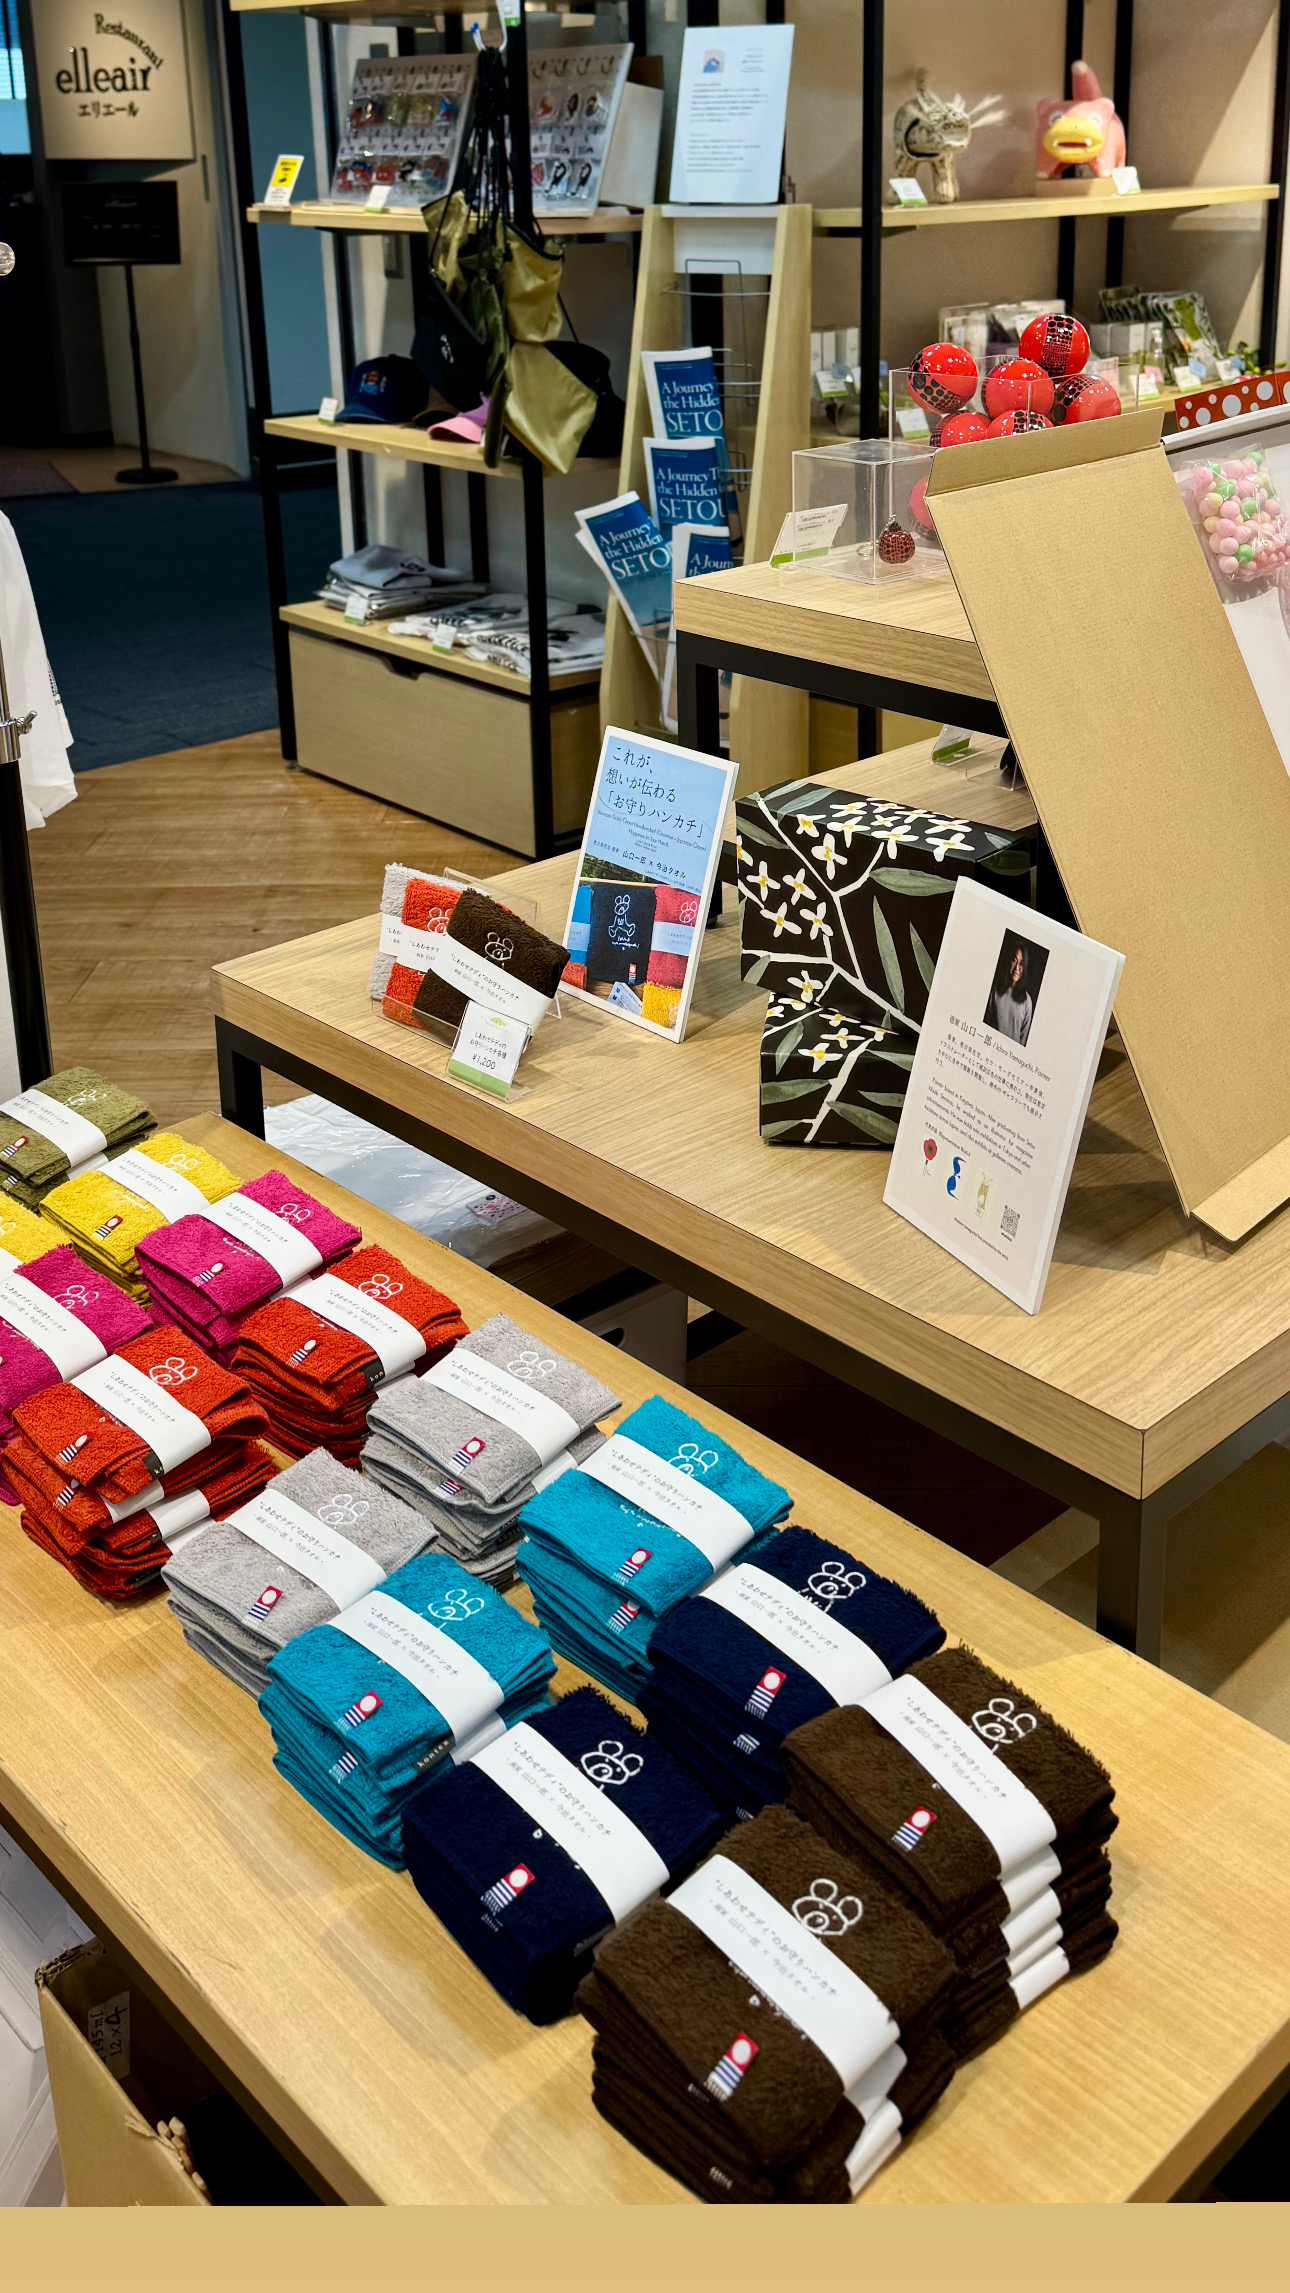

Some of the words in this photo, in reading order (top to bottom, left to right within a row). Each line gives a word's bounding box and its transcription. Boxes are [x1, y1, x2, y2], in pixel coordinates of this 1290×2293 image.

[94, 12, 164, 70] Restaurant
[56, 46, 151, 94] elleair
[78, 100, 140, 118] エリエール
[661, 382, 672, 394] A
[672, 381, 715, 398] Journey
[663, 396, 680, 409] the
[656, 467, 666, 480] A
[667, 468, 708, 486] Journey
[657, 481, 673, 495] the
[675, 483, 718, 496] Hidden
[600, 536, 610, 547] A
[611, 524, 651, 543] Journey
[604, 547, 622, 559] the
[690, 553, 701, 566] A
[612, 745, 653, 772] これが、
[606, 766, 677, 804] 想いが伝わる
[607, 790, 703, 837] 「お守りハンカチ」
[961, 1020, 992, 1047] 山口一郎
[1008, 1050, 1034, 1073] Yamaguchi,
[472, 1053, 496, 1070] ¥1,200
